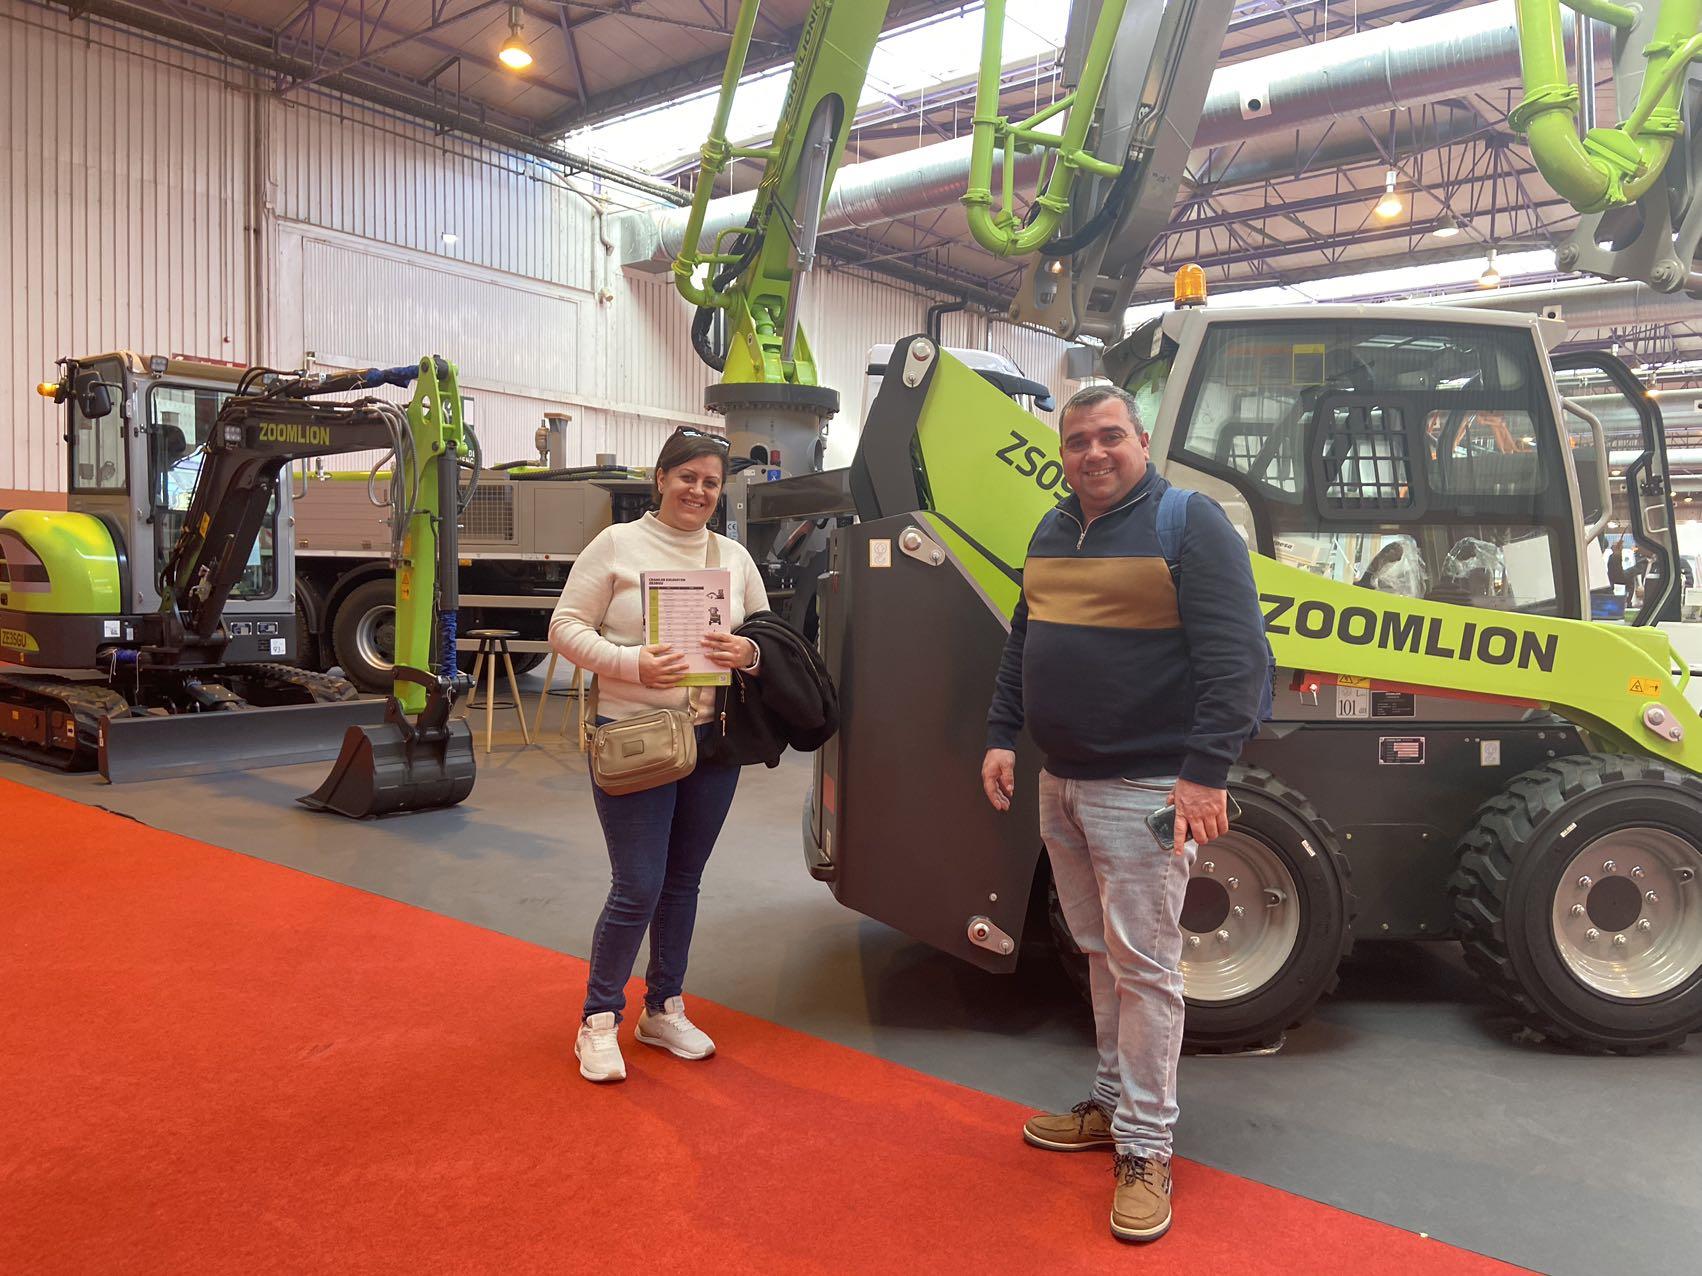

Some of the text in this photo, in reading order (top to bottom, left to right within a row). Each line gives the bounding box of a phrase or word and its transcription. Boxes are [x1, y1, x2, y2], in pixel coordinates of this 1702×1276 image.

[259, 423, 329, 445] ZOOMLION
[1259, 593, 1558, 672] ZOOMLION
[1339, 699, 1355, 716] 101
